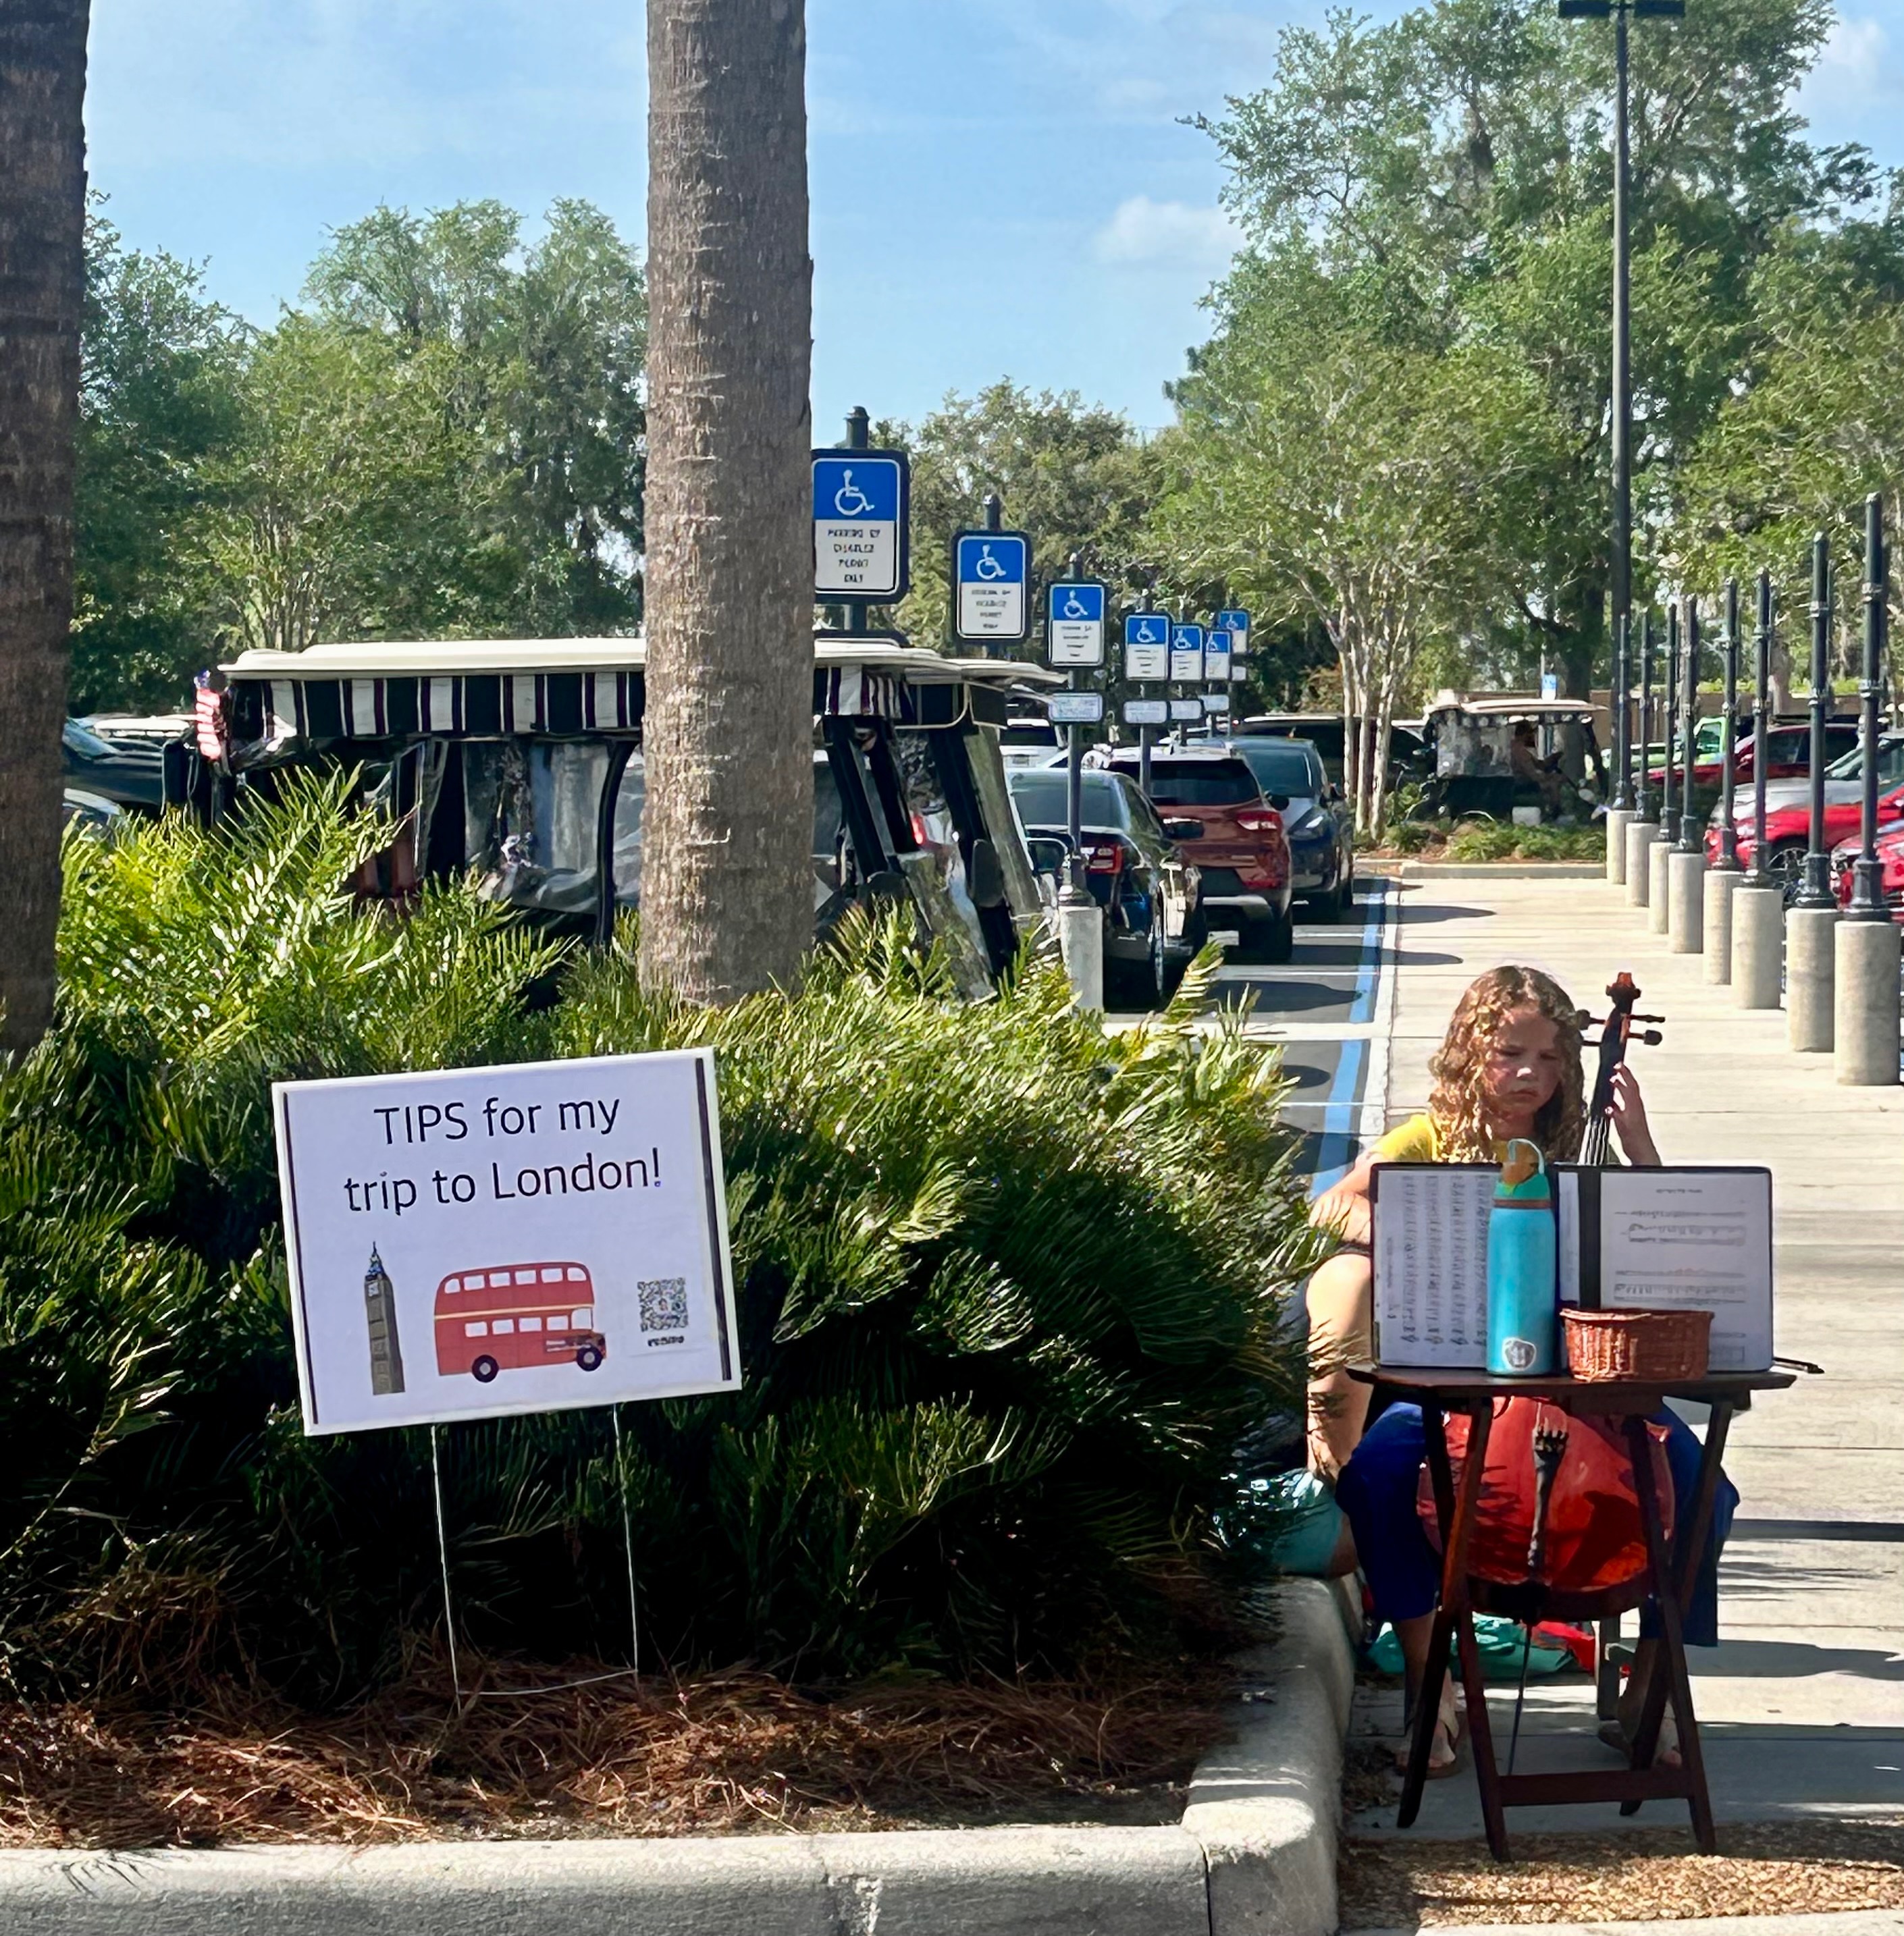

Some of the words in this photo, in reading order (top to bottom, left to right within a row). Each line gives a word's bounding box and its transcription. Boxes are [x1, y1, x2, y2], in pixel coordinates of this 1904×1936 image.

[373, 1101, 469, 1146] TIPS
[481, 1096, 543, 1137] for
[558, 1098, 620, 1136] my
[342, 1171, 418, 1217] trip
[431, 1169, 477, 1205] to
[491, 1146, 662, 1200] London!
